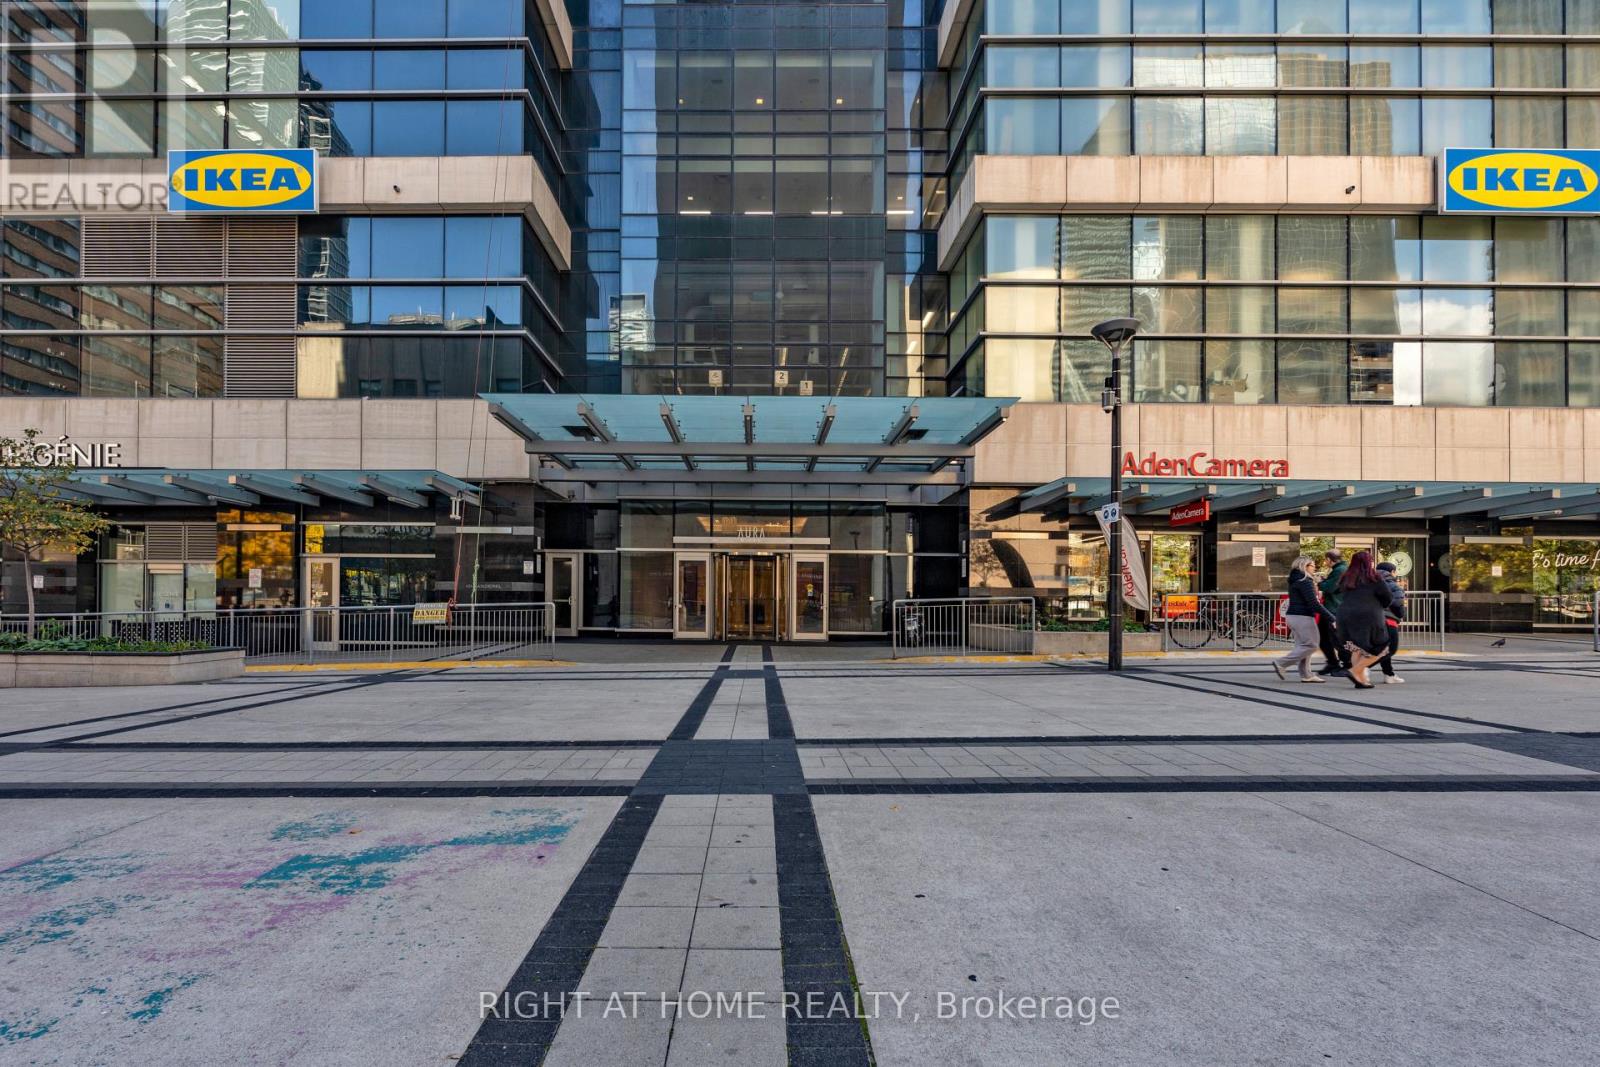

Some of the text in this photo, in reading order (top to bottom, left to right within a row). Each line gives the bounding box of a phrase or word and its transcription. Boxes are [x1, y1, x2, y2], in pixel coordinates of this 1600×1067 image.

[184, 167, 302, 192] IKEA
[1462, 167, 1588, 192] IKEA
[32, 435, 120, 467] GÉNIE
[1121, 451, 1289, 477] AdenCamera
[1171, 507, 1204, 521] AdenCamera
[738, 527, 765, 538] AURA
[1555, 552, 1589, 567] time
[415, 609, 445, 617] DANGER
